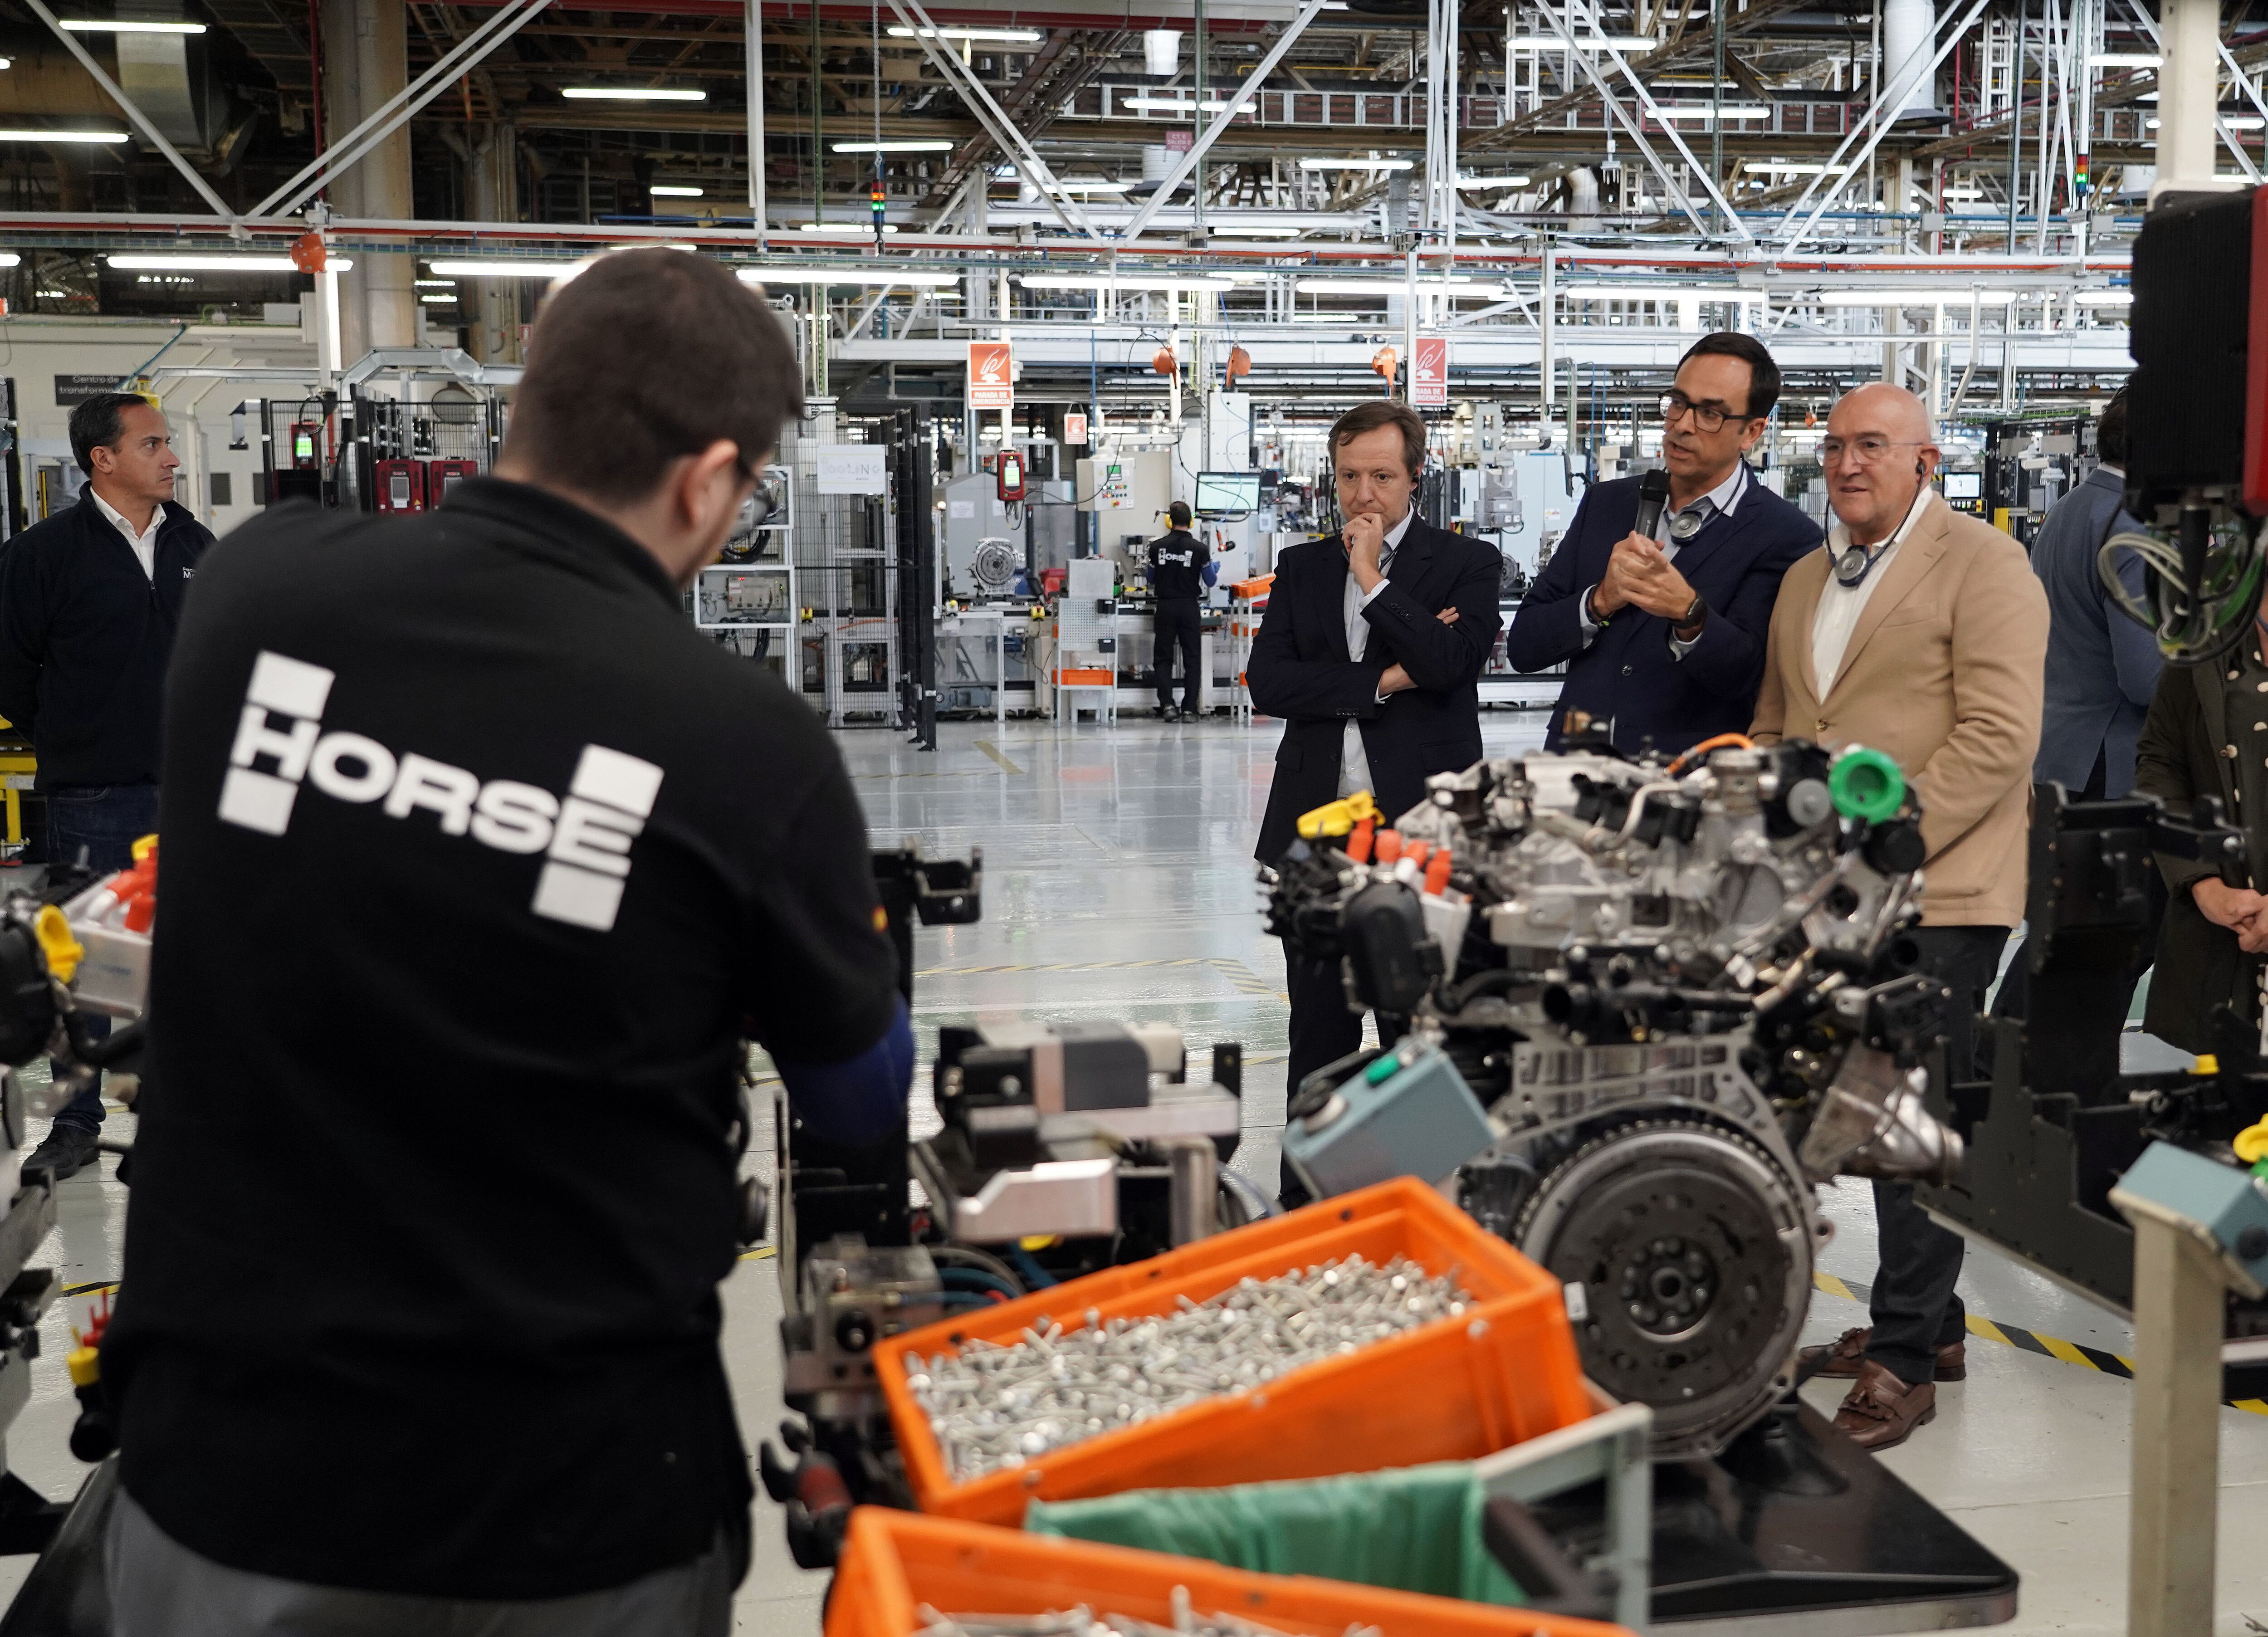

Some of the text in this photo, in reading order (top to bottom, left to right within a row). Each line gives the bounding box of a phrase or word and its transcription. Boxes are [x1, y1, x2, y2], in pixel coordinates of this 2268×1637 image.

[59, 386, 114, 394] transforma
[1158, 548, 1193, 567] HORSE
[218, 649, 664, 932] HORSE
